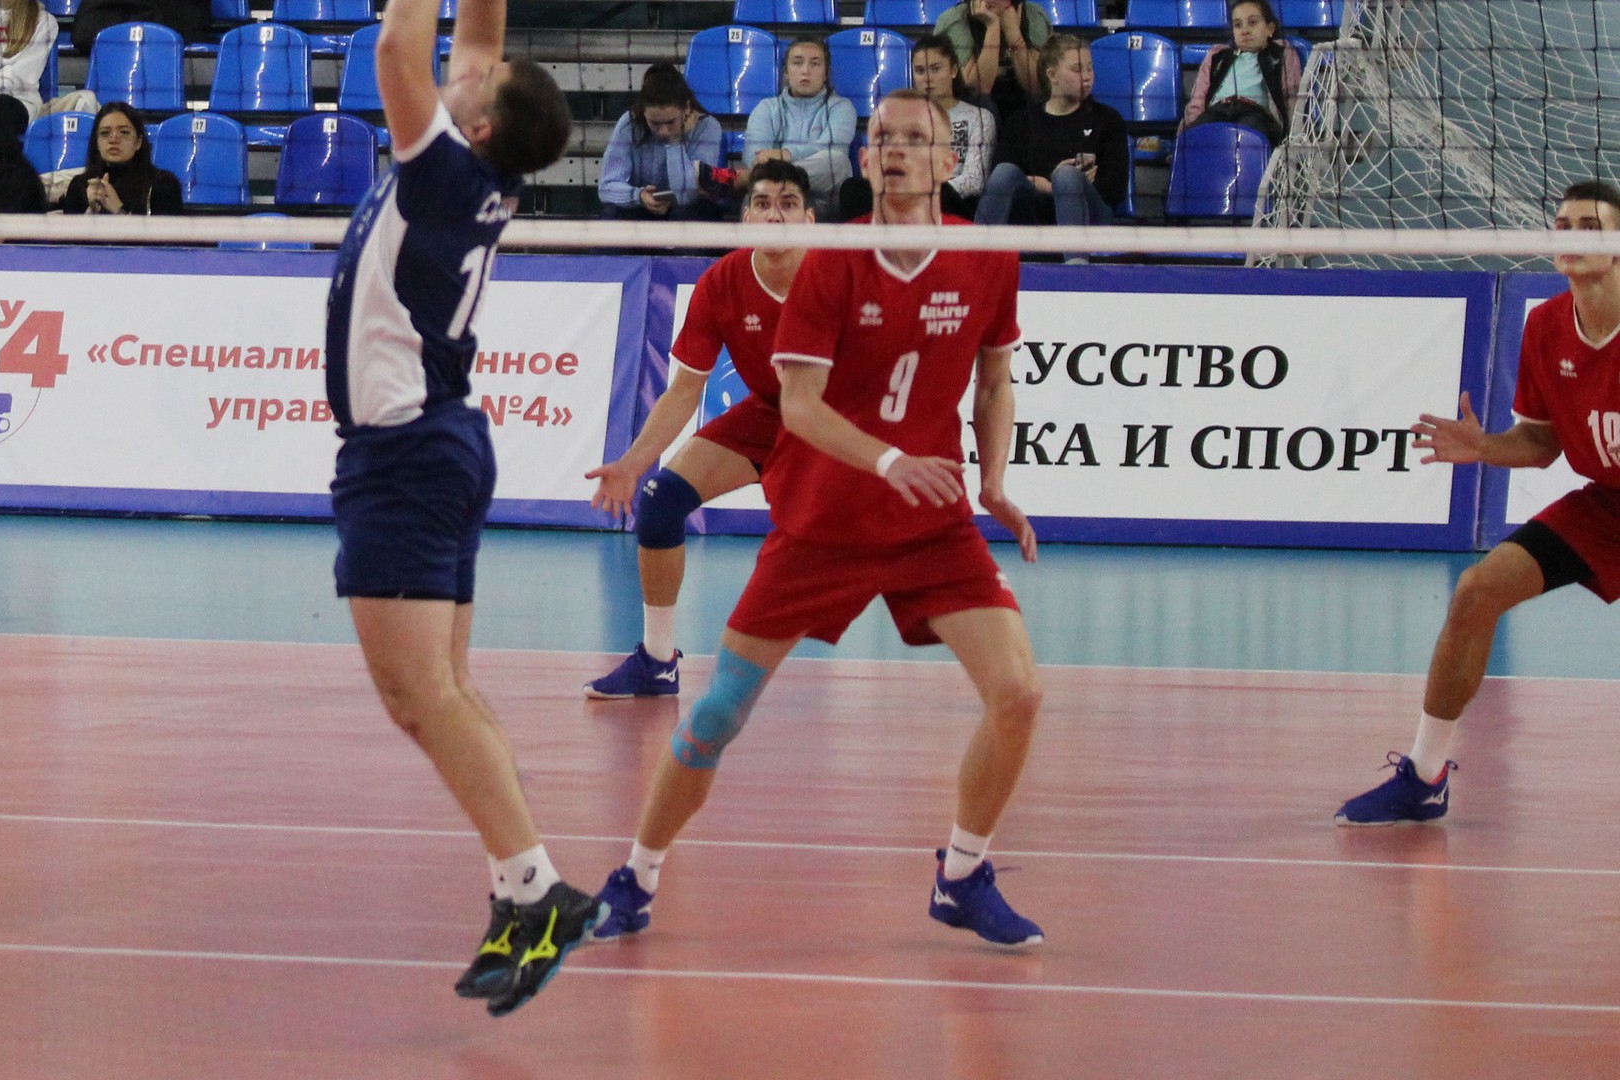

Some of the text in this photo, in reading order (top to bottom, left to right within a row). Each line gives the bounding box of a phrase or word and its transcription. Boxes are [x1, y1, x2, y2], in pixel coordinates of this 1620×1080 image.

[880, 350, 920, 422] 9
[1012, 341, 1290, 390] УССТВО
[206, 396, 337, 431] управ
[1119, 424, 1173, 468] И
[1191, 425, 1421, 472] СПОРТ
